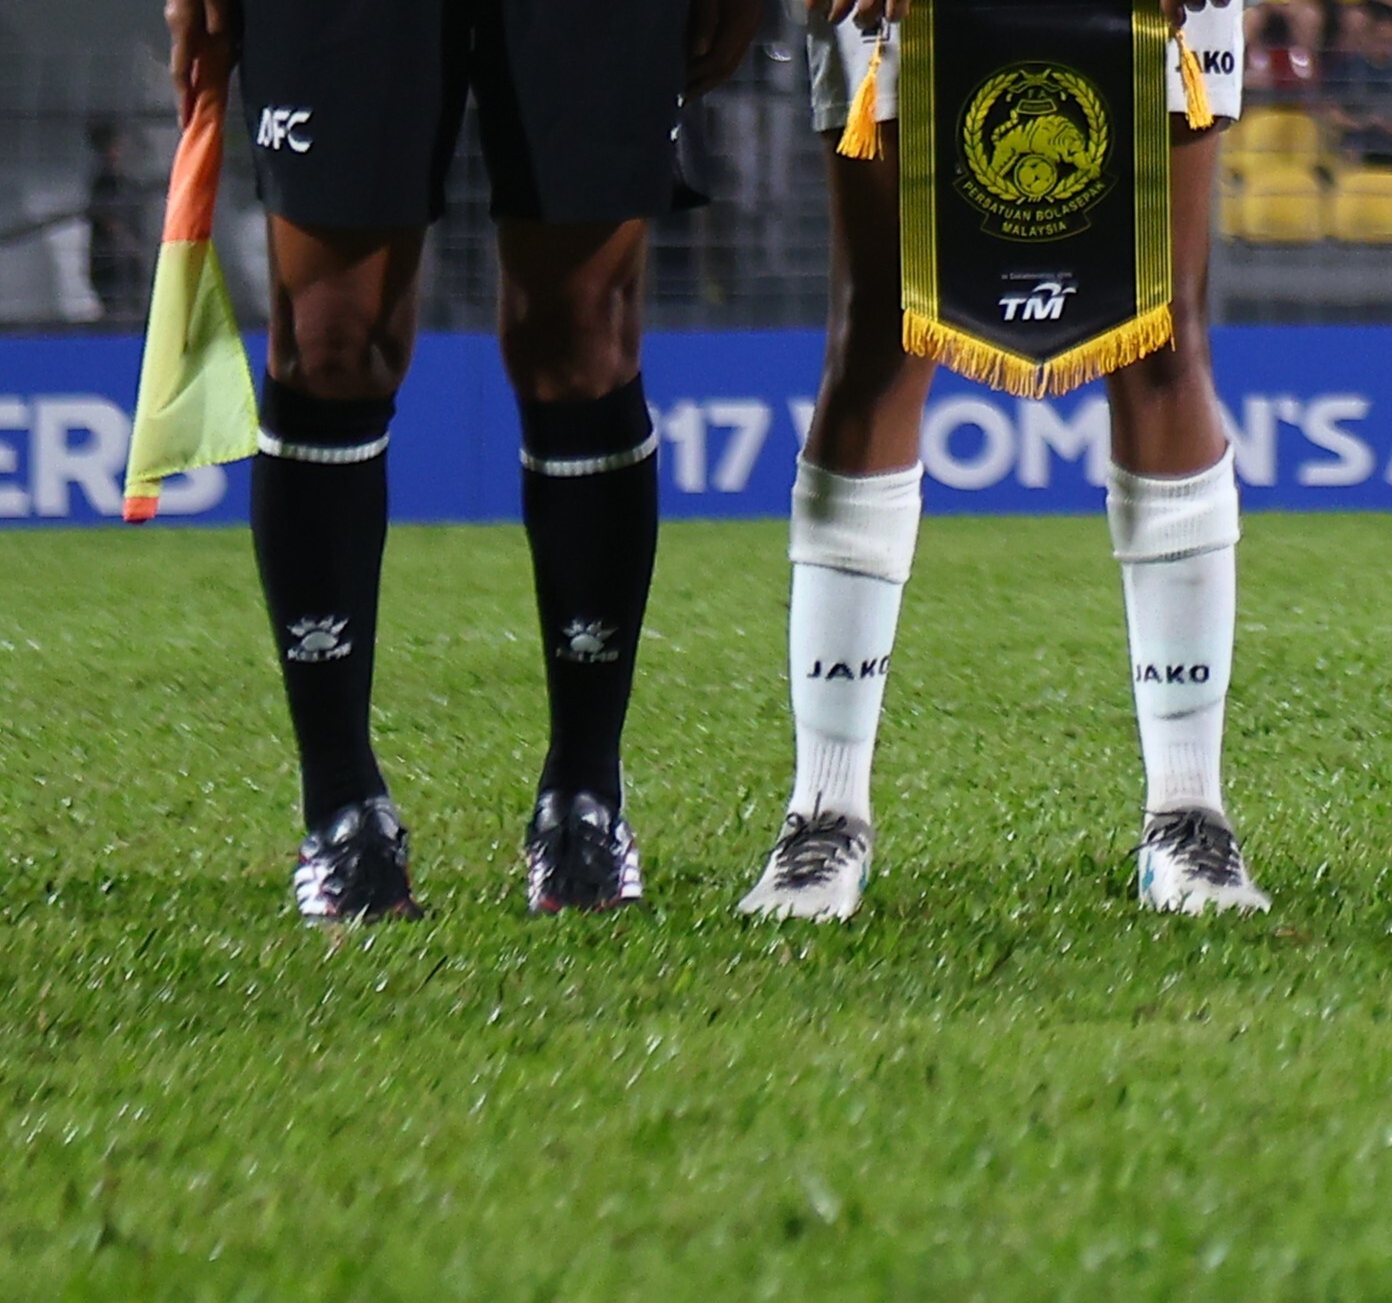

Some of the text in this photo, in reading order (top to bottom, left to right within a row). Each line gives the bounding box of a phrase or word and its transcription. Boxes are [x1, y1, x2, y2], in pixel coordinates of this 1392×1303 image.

[257, 107, 313, 153] AFC
[962, 181, 1106, 222] PERSATUAN BOLASEPAK
[1002, 220, 1067, 238] MALAYSIA
[998, 297, 1066, 320] TM
[657, 398, 773, 494] 17
[1135, 664, 1211, 685] JAKO
